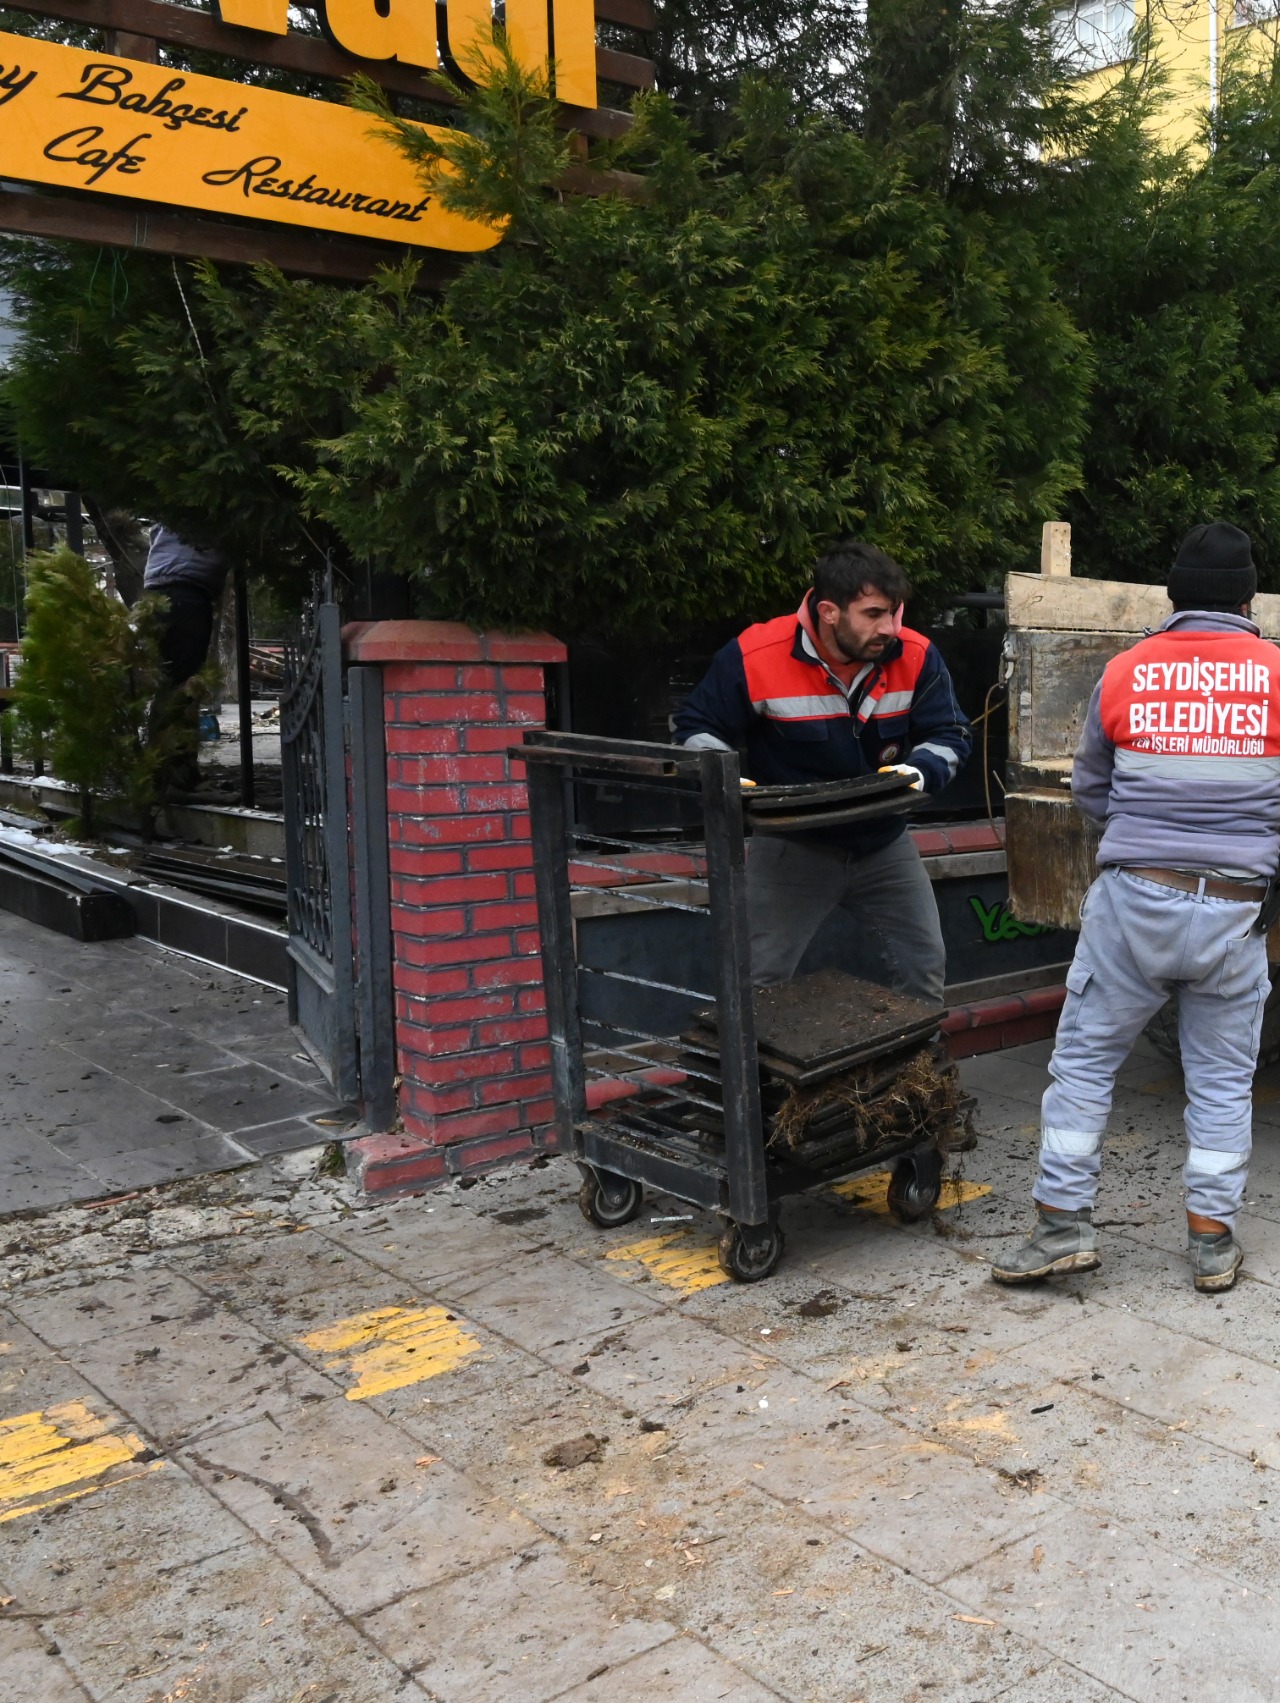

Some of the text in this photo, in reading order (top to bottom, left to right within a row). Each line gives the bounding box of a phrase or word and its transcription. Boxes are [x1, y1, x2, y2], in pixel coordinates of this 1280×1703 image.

[57, 63, 248, 131] Bahçesi
[43, 126, 431, 222] Cafe Restaurant
[1132, 656, 1270, 697] SEYDİŞEHİR
[1129, 697, 1268, 737] BELEDİYESİ
[1151, 734, 1190, 754] İŞLERİ
[1191, 735, 1265, 756] MÜDÜRLÜĞÜ
